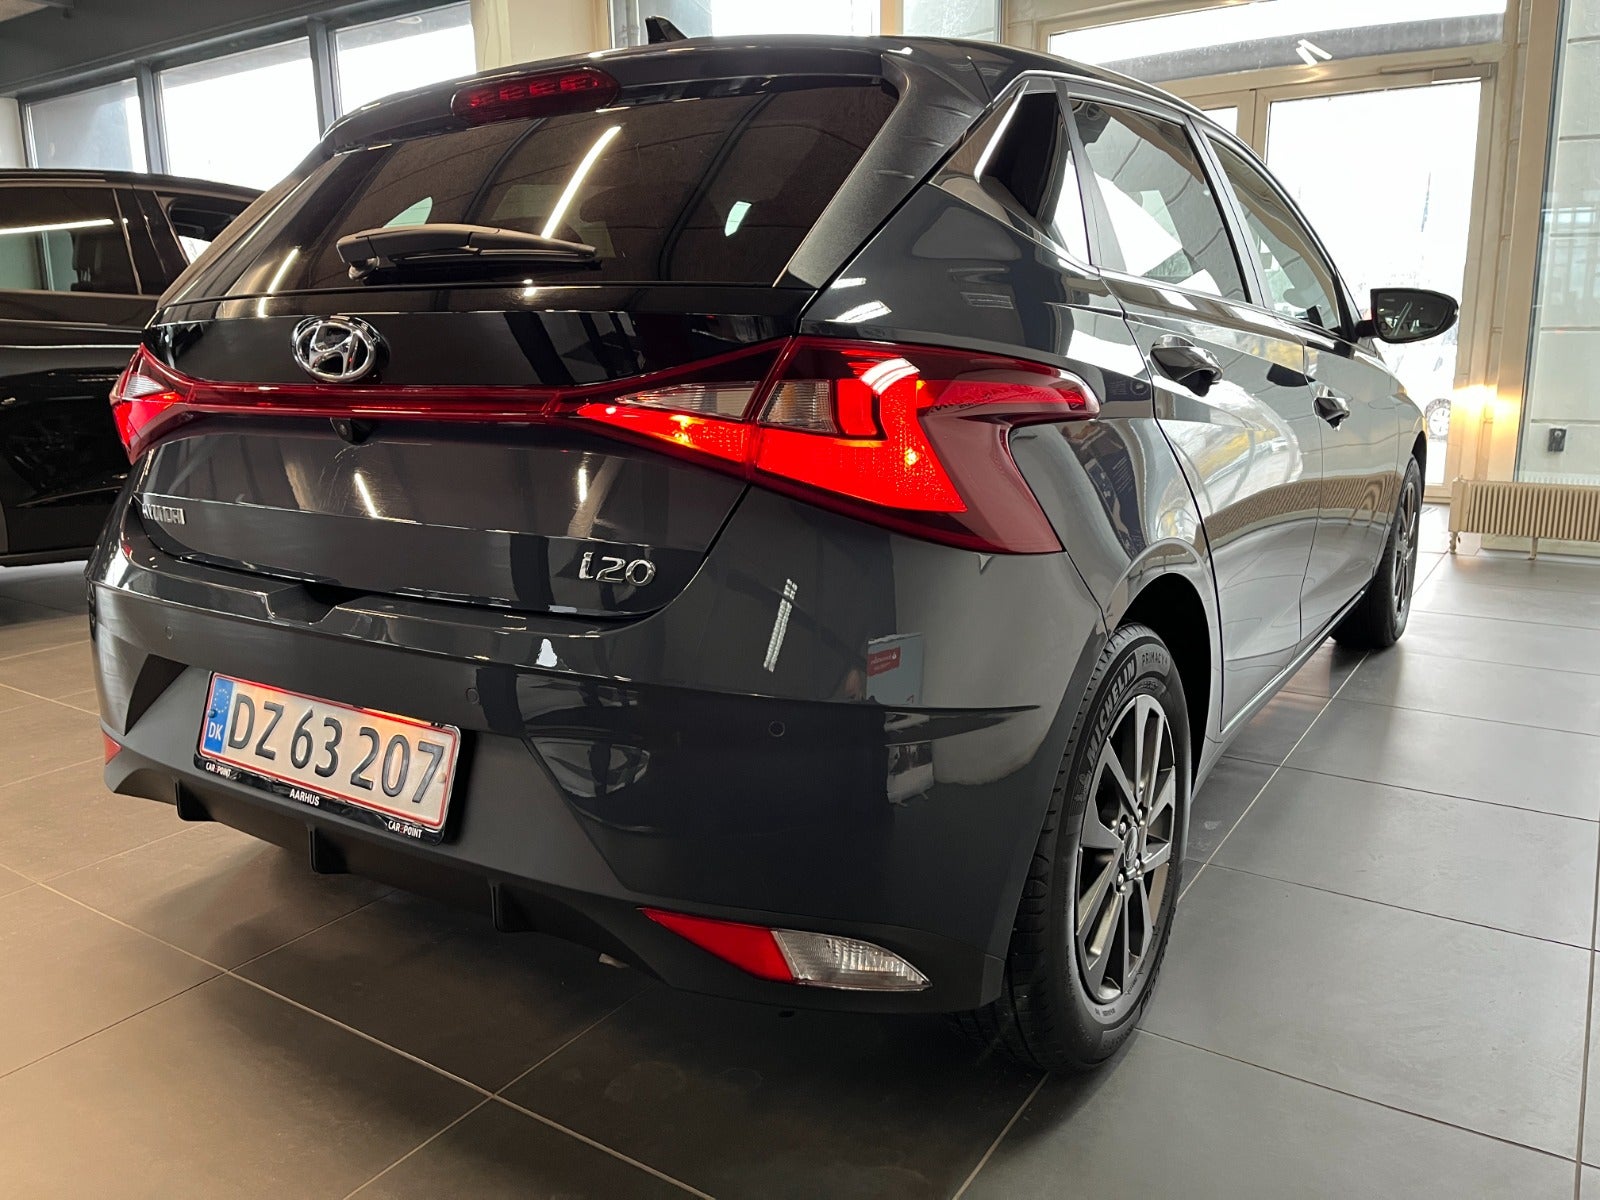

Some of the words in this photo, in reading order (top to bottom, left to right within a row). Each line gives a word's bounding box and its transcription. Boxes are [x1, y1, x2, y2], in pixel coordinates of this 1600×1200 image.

[1086, 659, 1136, 768] MICHELIN
[208, 721, 224, 741] DK
[289, 788, 320, 806] AARHUS
